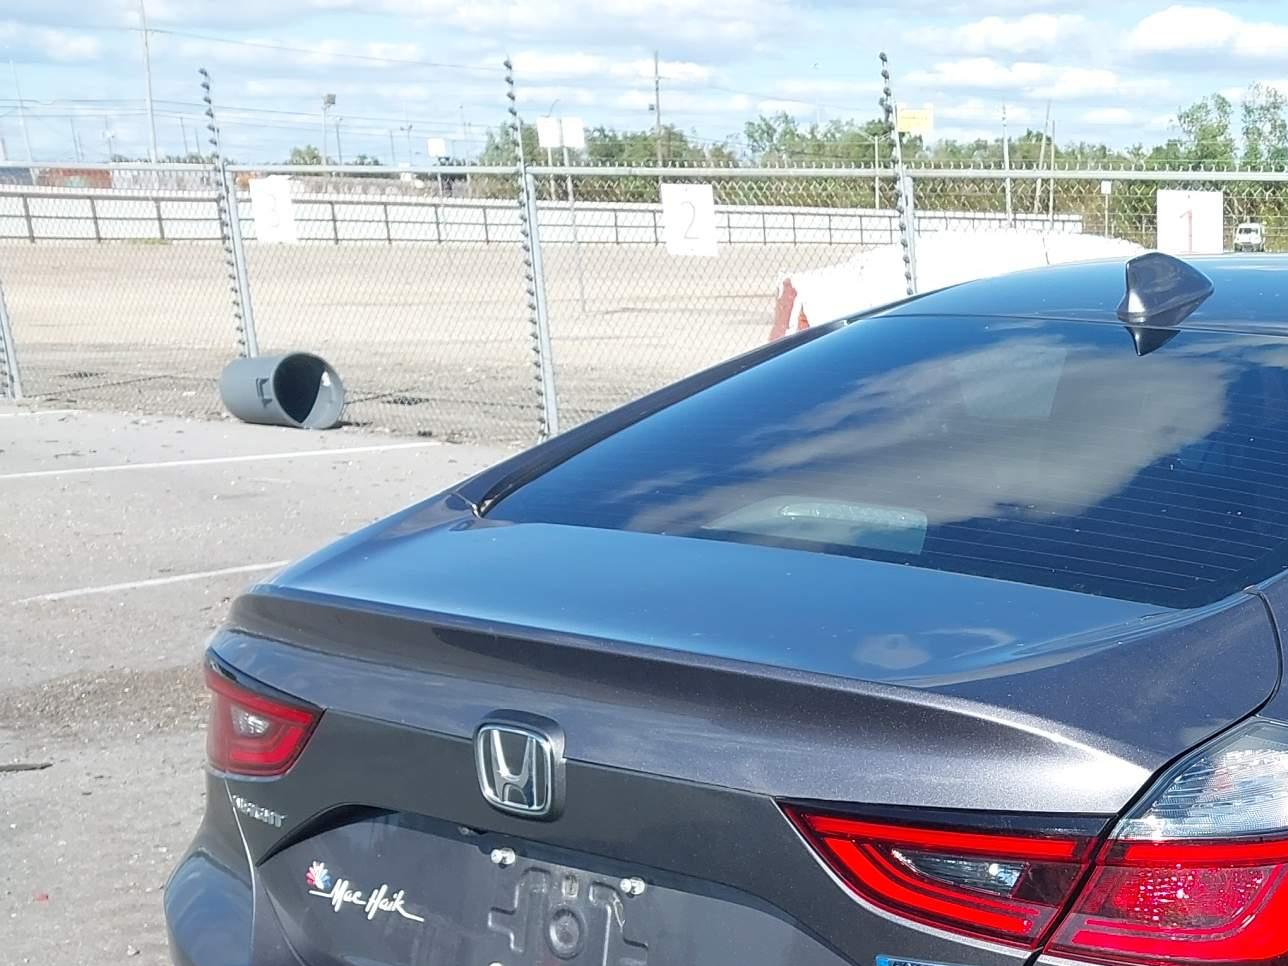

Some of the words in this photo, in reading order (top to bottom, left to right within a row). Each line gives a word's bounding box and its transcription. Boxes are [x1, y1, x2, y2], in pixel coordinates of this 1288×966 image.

[681, 200, 701, 240] 2
[1179, 208, 1193, 255] 1
[308, 878, 367, 913] Mac
[364, 883, 425, 922] Haik
